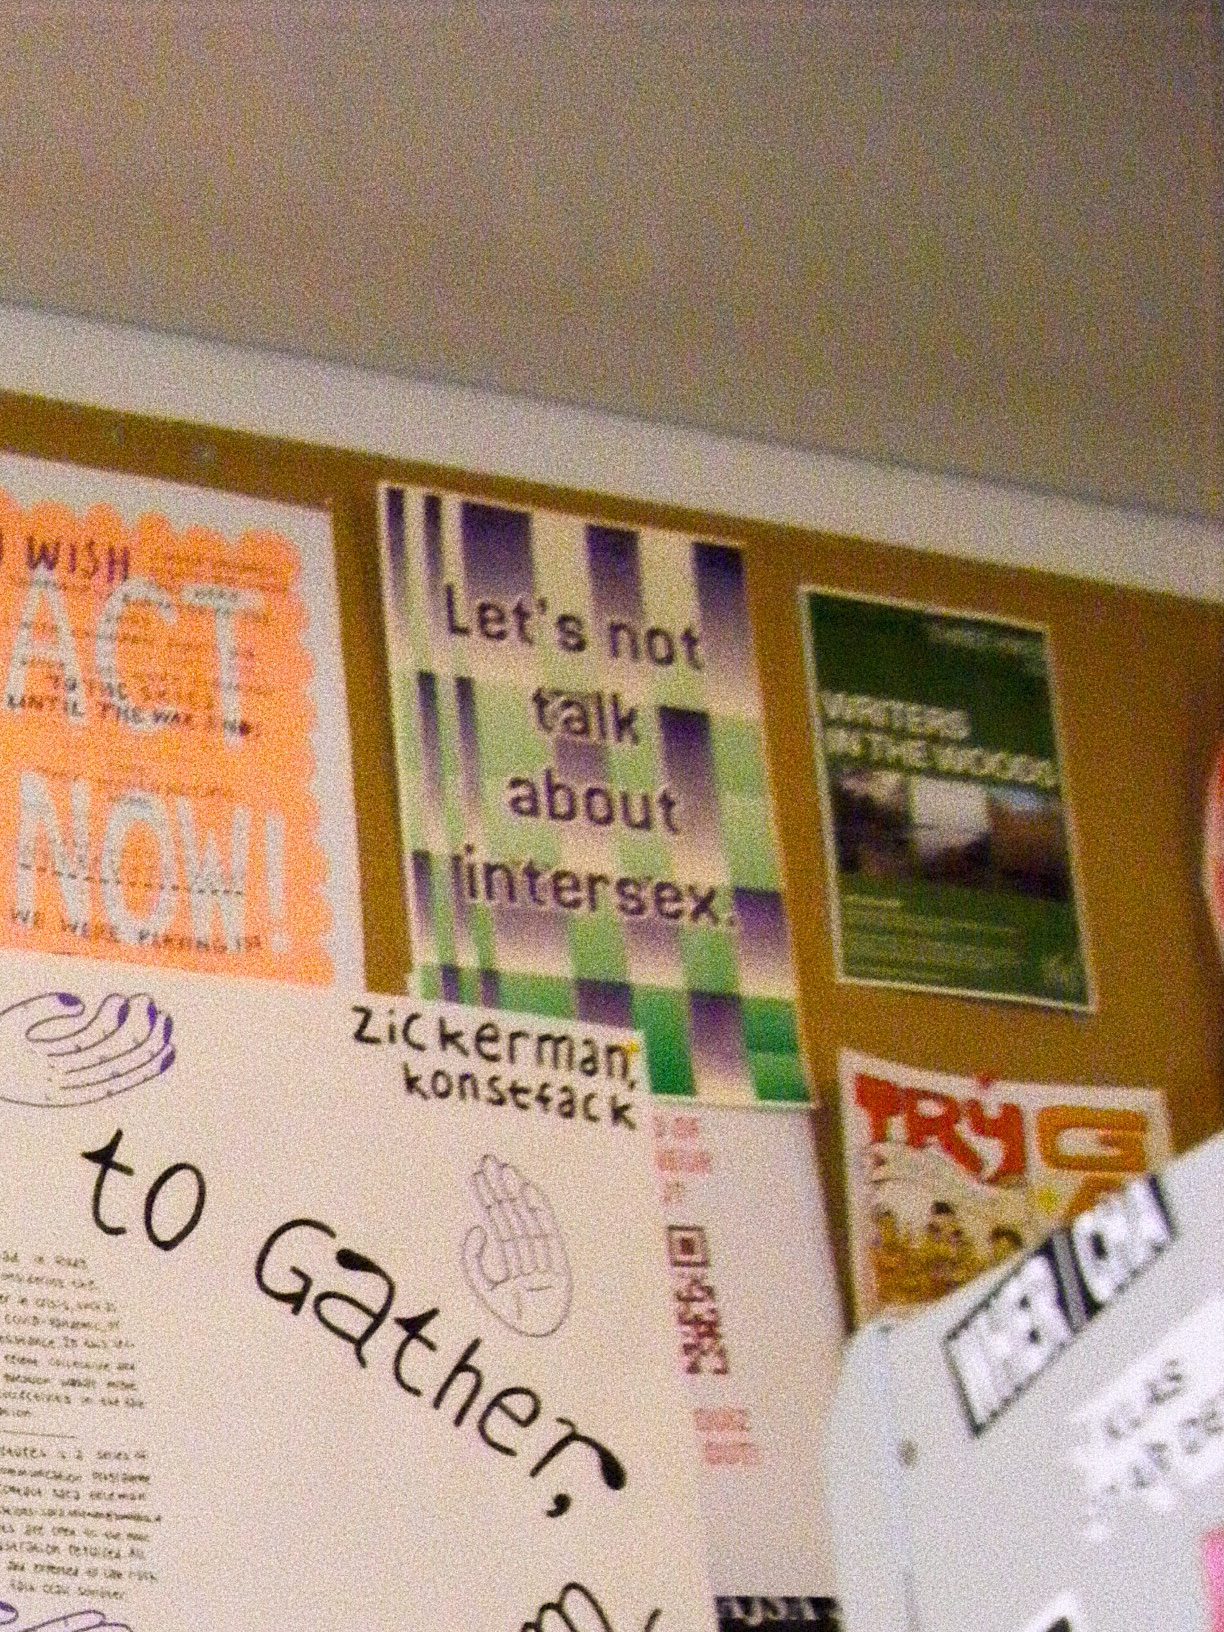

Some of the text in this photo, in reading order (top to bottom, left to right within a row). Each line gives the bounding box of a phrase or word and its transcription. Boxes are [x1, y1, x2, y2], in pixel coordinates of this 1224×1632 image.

[26, 536, 130, 582] WISH
[3, 566, 265, 748] ACT
[445, 583, 703, 670] Let's not
[533, 687, 639, 745] talk
[507, 768, 680, 835] about
[81, 1129, 206, 1251] to
